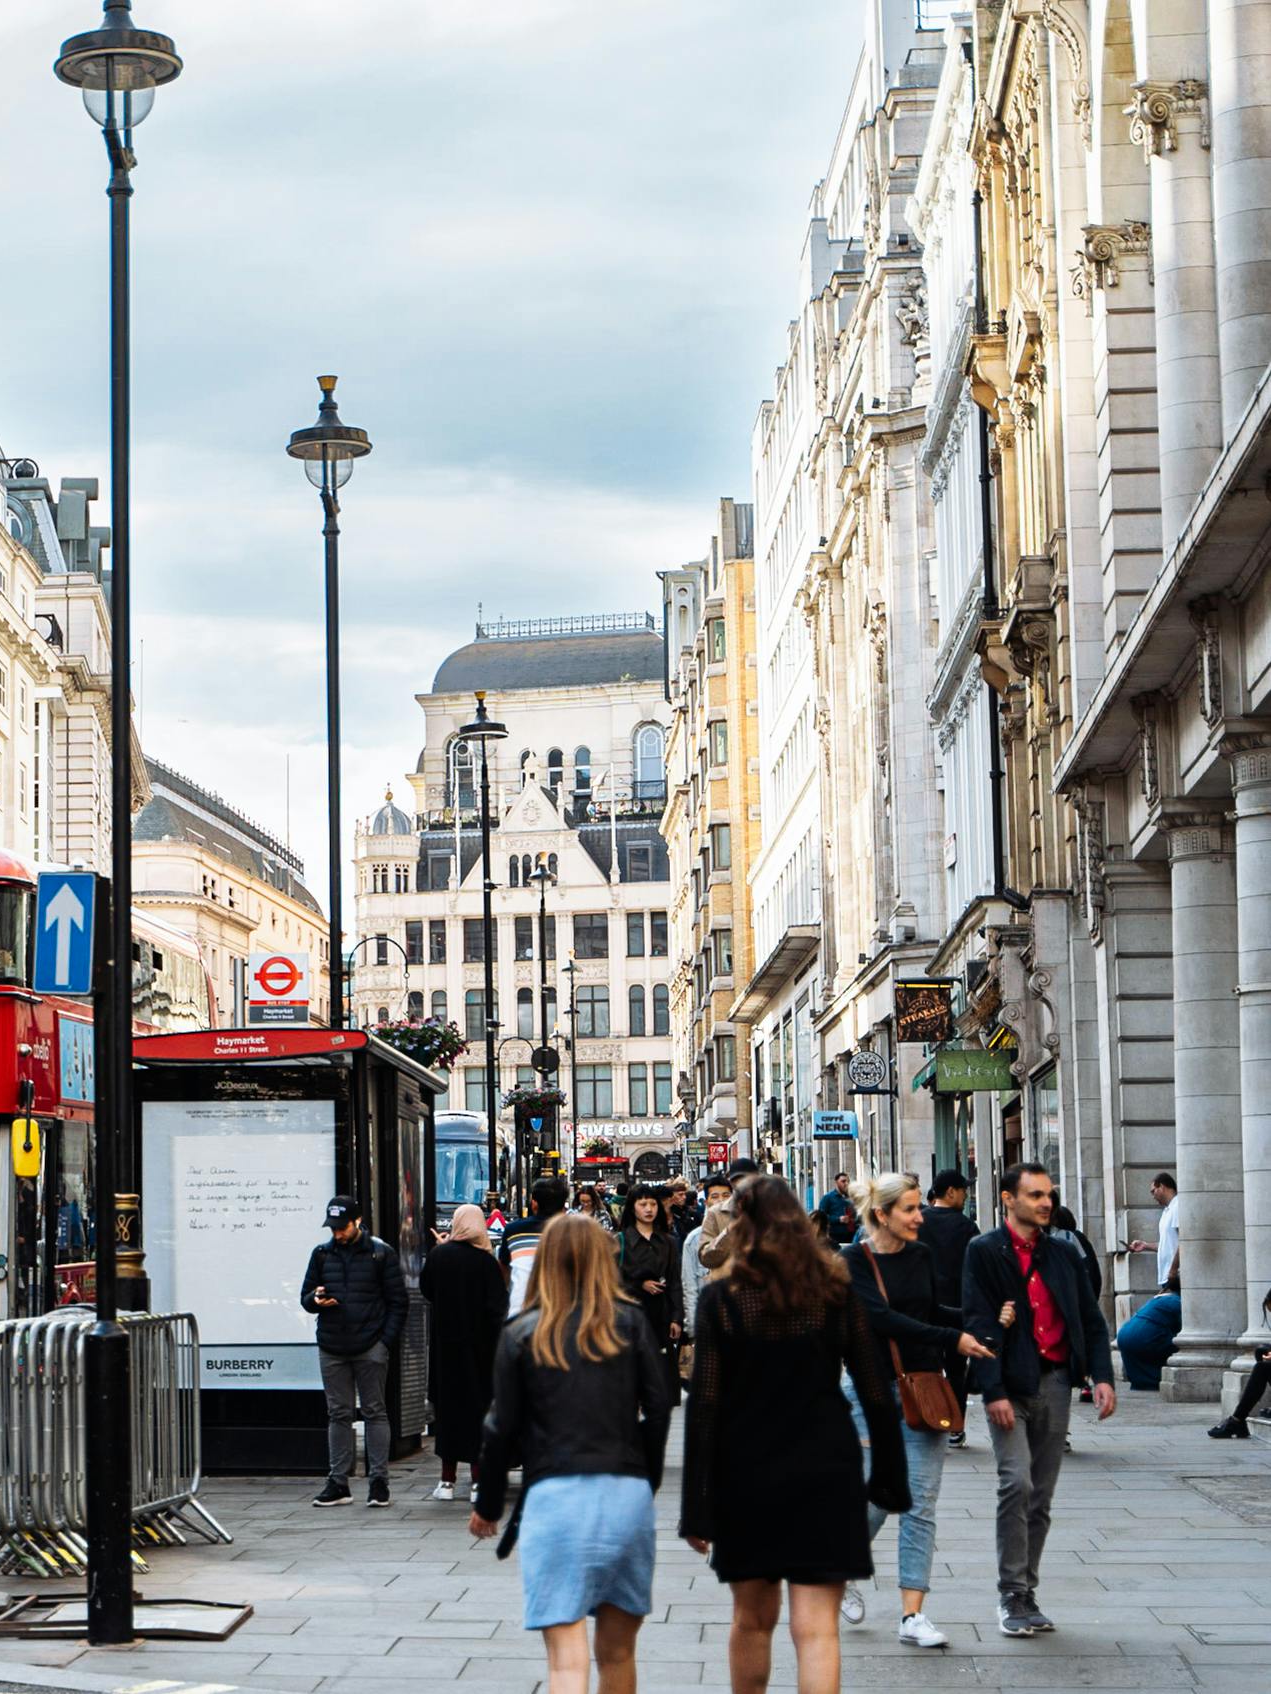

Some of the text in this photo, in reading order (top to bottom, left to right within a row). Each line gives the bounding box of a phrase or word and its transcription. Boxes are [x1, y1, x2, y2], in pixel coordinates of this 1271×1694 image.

[216, 1036, 265, 1047] Haymarket
[213, 1047, 238, 1055] Charles
[214, 1081, 260, 1090] JCDecaux
[578, 1123, 664, 1136] FIVE GUYS
[816, 1123, 850, 1131] NERO
[206, 1360, 274, 1370] BURBERRY
